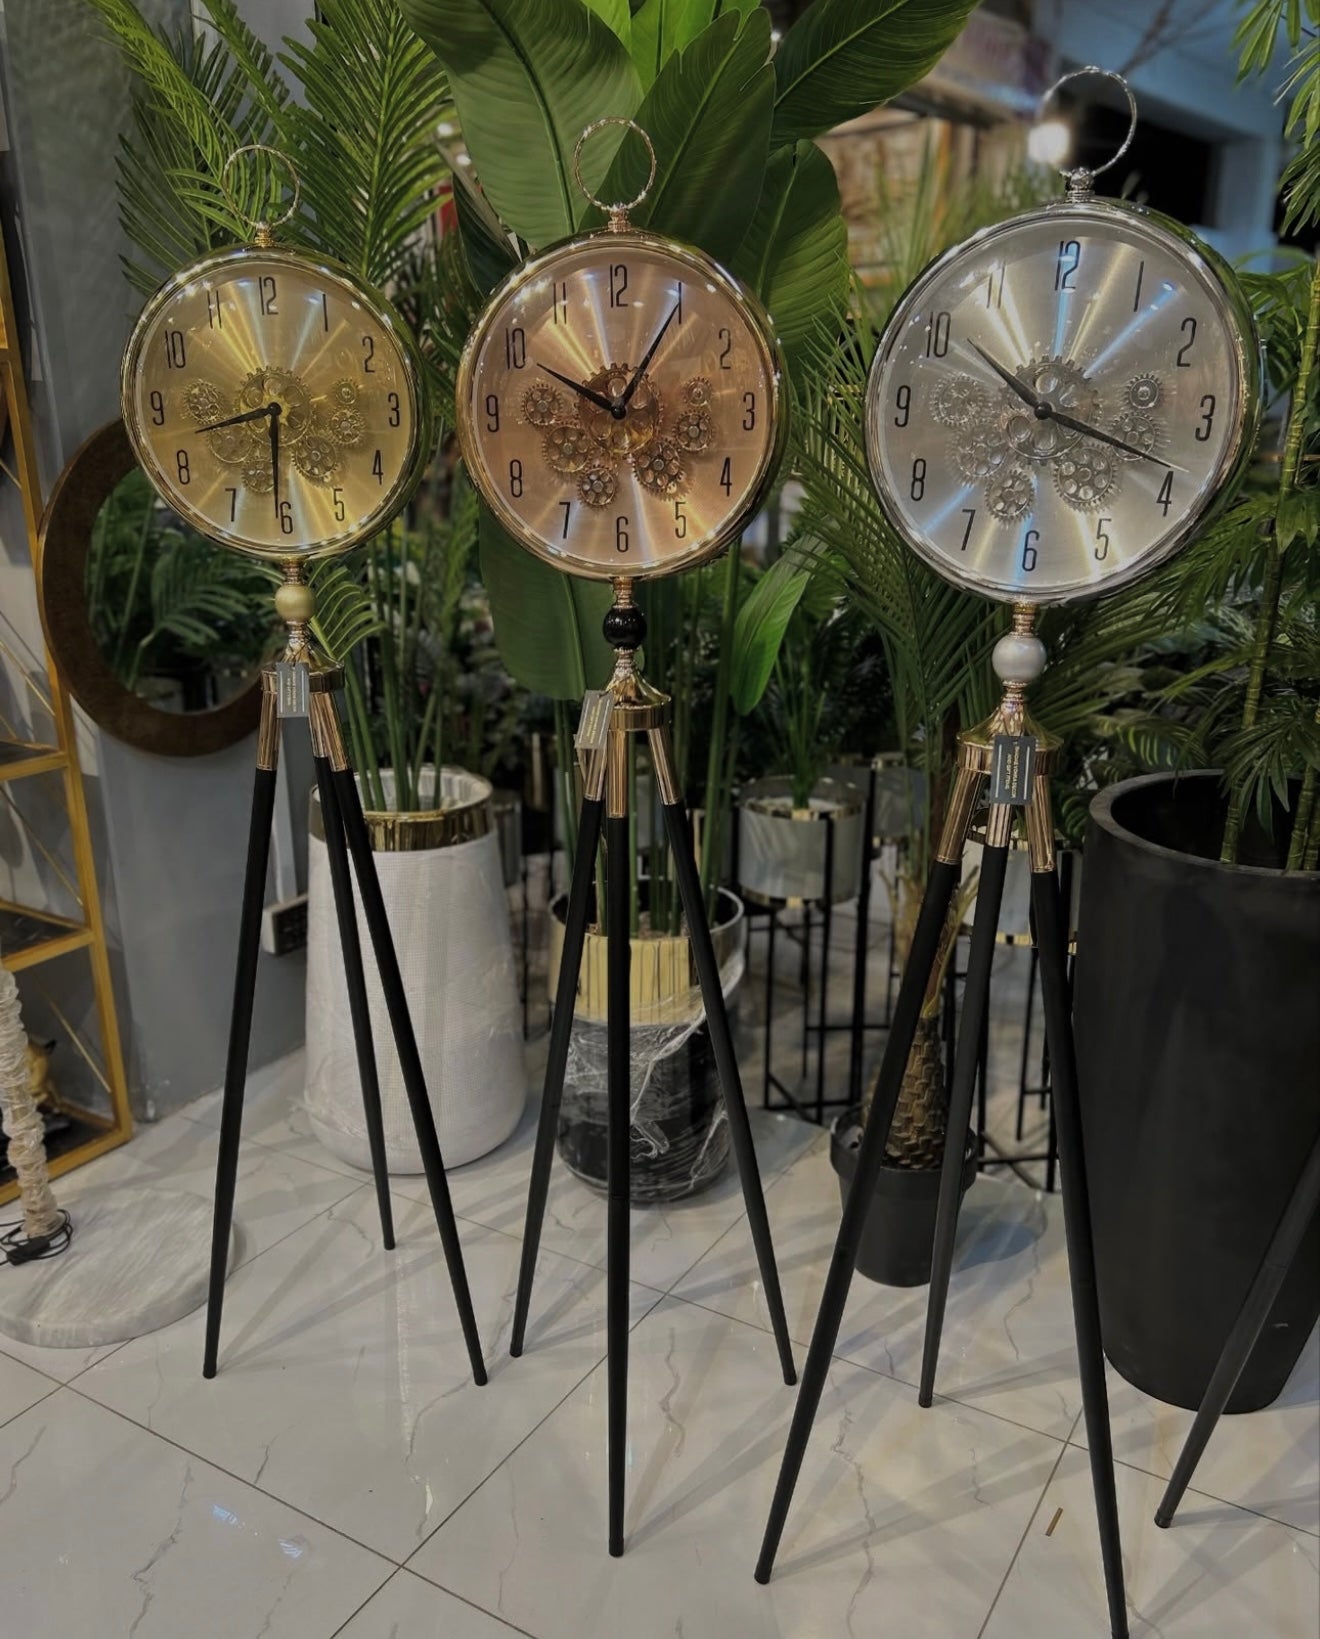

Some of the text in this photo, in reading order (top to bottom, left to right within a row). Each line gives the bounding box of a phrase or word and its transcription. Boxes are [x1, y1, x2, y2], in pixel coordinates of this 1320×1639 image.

[987, 261, 1005, 308] 11
[1055, 241, 1080, 290] 12
[259, 276, 278, 315] 12
[553, 282, 566, 324] 11
[610, 264, 628, 307] 12
[1134, 261, 1144, 312] 1
[207, 290, 222, 328] 11
[322, 293, 328, 331] 1
[165, 330, 186, 368] 10
[362, 336, 375, 372] 2
[506, 328, 525, 369] 10
[719, 329, 731, 369] 2
[927, 311, 950, 358] 10
[1177, 318, 1197, 367] 2
[150, 391, 164, 425] 9
[388, 393, 400, 427] 3
[486, 395, 499, 432] 9
[743, 392, 755, 430] 3
[895, 386, 911, 427] 9
[1195, 395, 1215, 441] 3
[176, 450, 190, 484] 8
[372, 450, 383, 484] 4
[510, 460, 522, 498] 8
[720, 457, 732, 496] 4
[911, 459, 926, 500] 8
[225, 488, 236, 521] 7
[333, 489, 345, 521] 5
[1156, 471, 1173, 516] 4
[279, 501, 293, 534] 6
[559, 502, 570, 539] 7
[617, 516, 628, 552] 6
[675, 502, 686, 538] 5
[961, 510, 976, 551] 7
[1022, 530, 1039, 571] 6
[1095, 519, 1112, 560] 5
